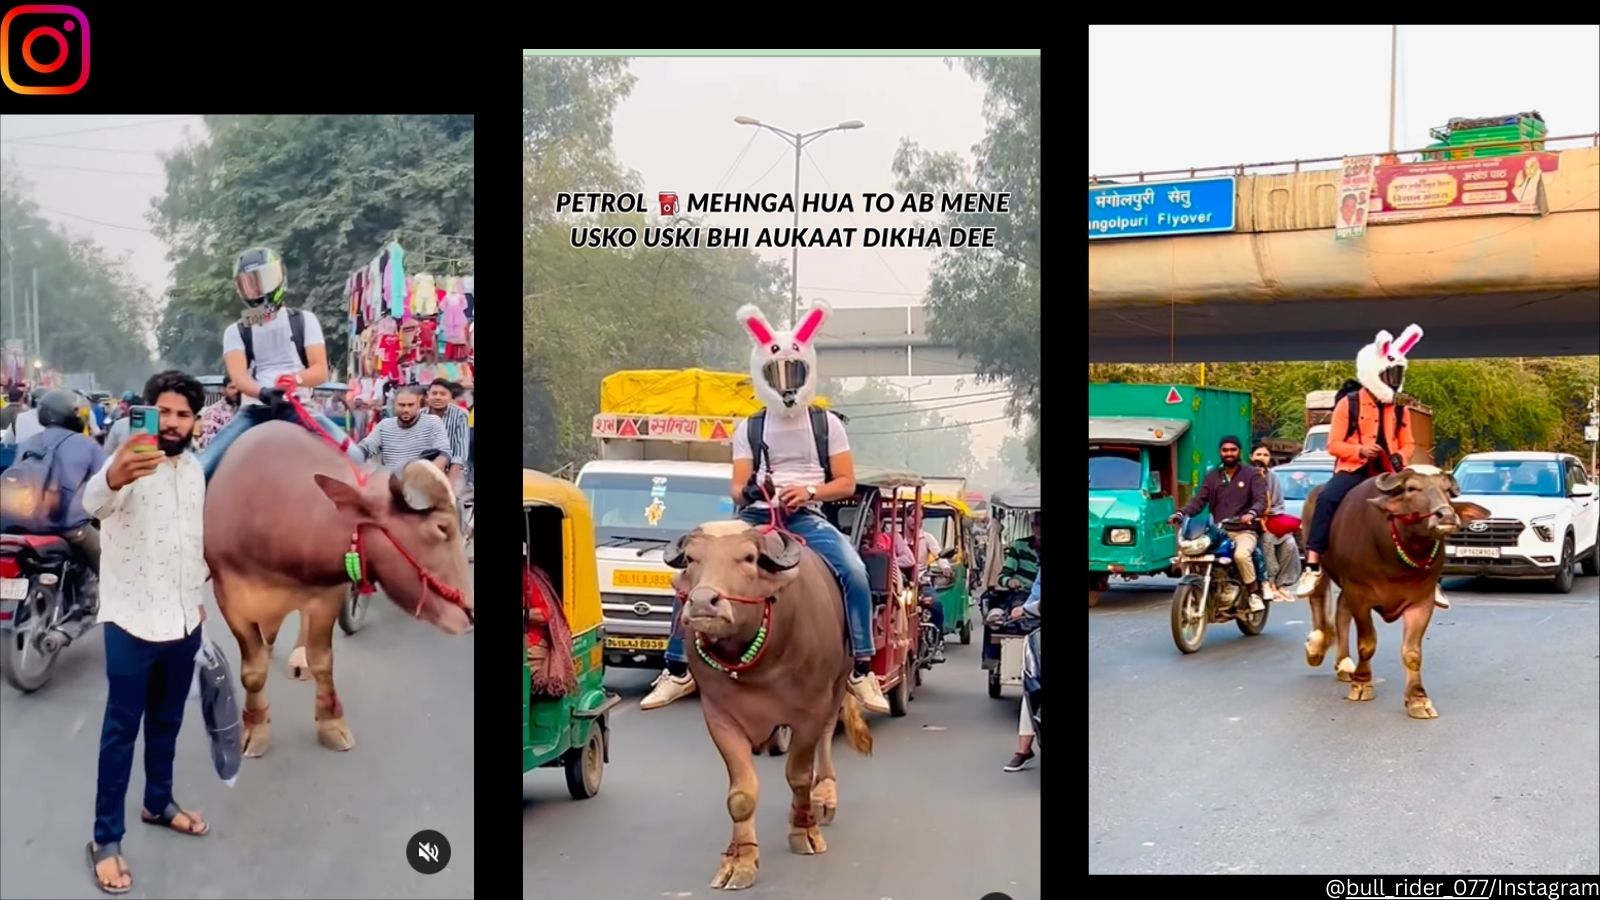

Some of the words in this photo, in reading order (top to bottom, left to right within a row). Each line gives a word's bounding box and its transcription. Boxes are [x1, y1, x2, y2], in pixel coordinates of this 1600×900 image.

[1095, 187, 1155, 211] मंगोलपुरी
[1167, 186, 1192, 208] सेतु
[1089, 214, 1149, 233] ngolpuri
[1157, 212, 1213, 228] Flyover
